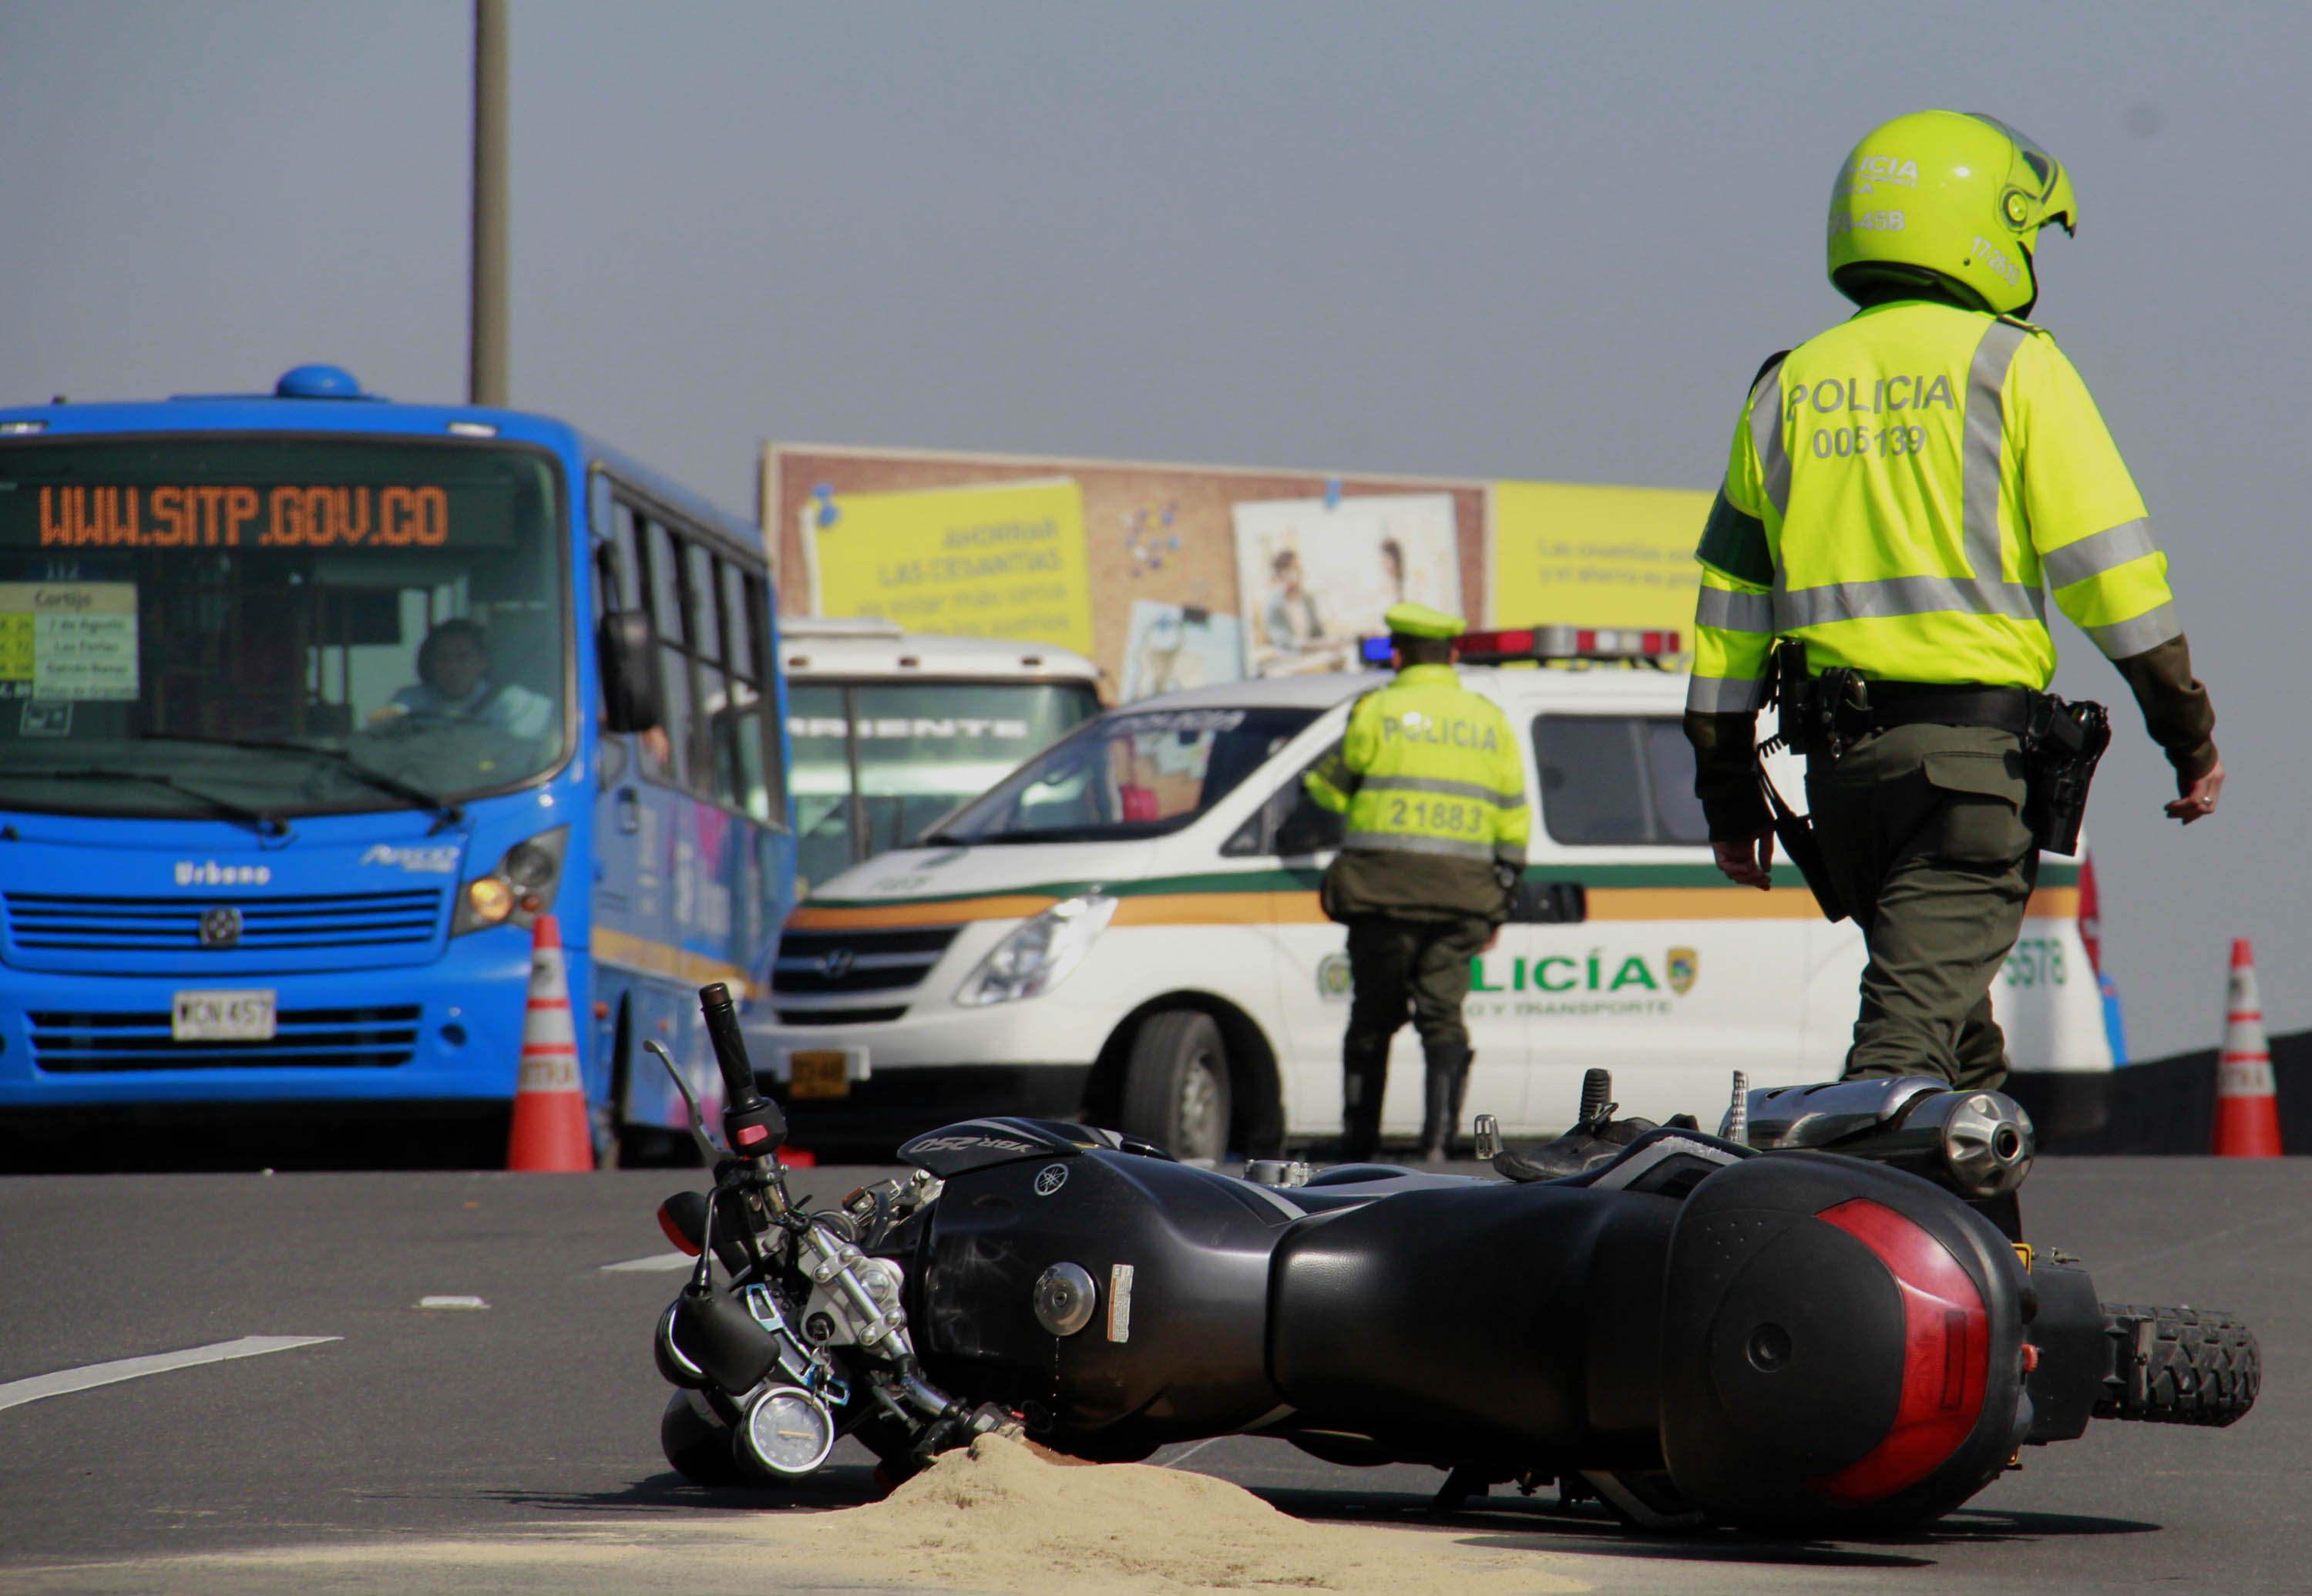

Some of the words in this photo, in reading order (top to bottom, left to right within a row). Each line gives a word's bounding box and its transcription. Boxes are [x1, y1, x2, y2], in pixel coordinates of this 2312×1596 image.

[1847, 154, 1918, 180] LICIA
[1786, 375, 1955, 422] POLICIA
[1813, 425, 1925, 459] 005139
[40, 486, 449, 546] WWW.SITP.GOV.CO
[1383, 714, 1497, 753] POLICIA
[1390, 798, 1484, 834] 21883
[1469, 947, 1658, 992] LICÍA
[1514, 1000, 1668, 1016] TRANSPORTE
[909, 1136, 982, 1154] 250
[977, 1137, 1033, 1154] YBR
